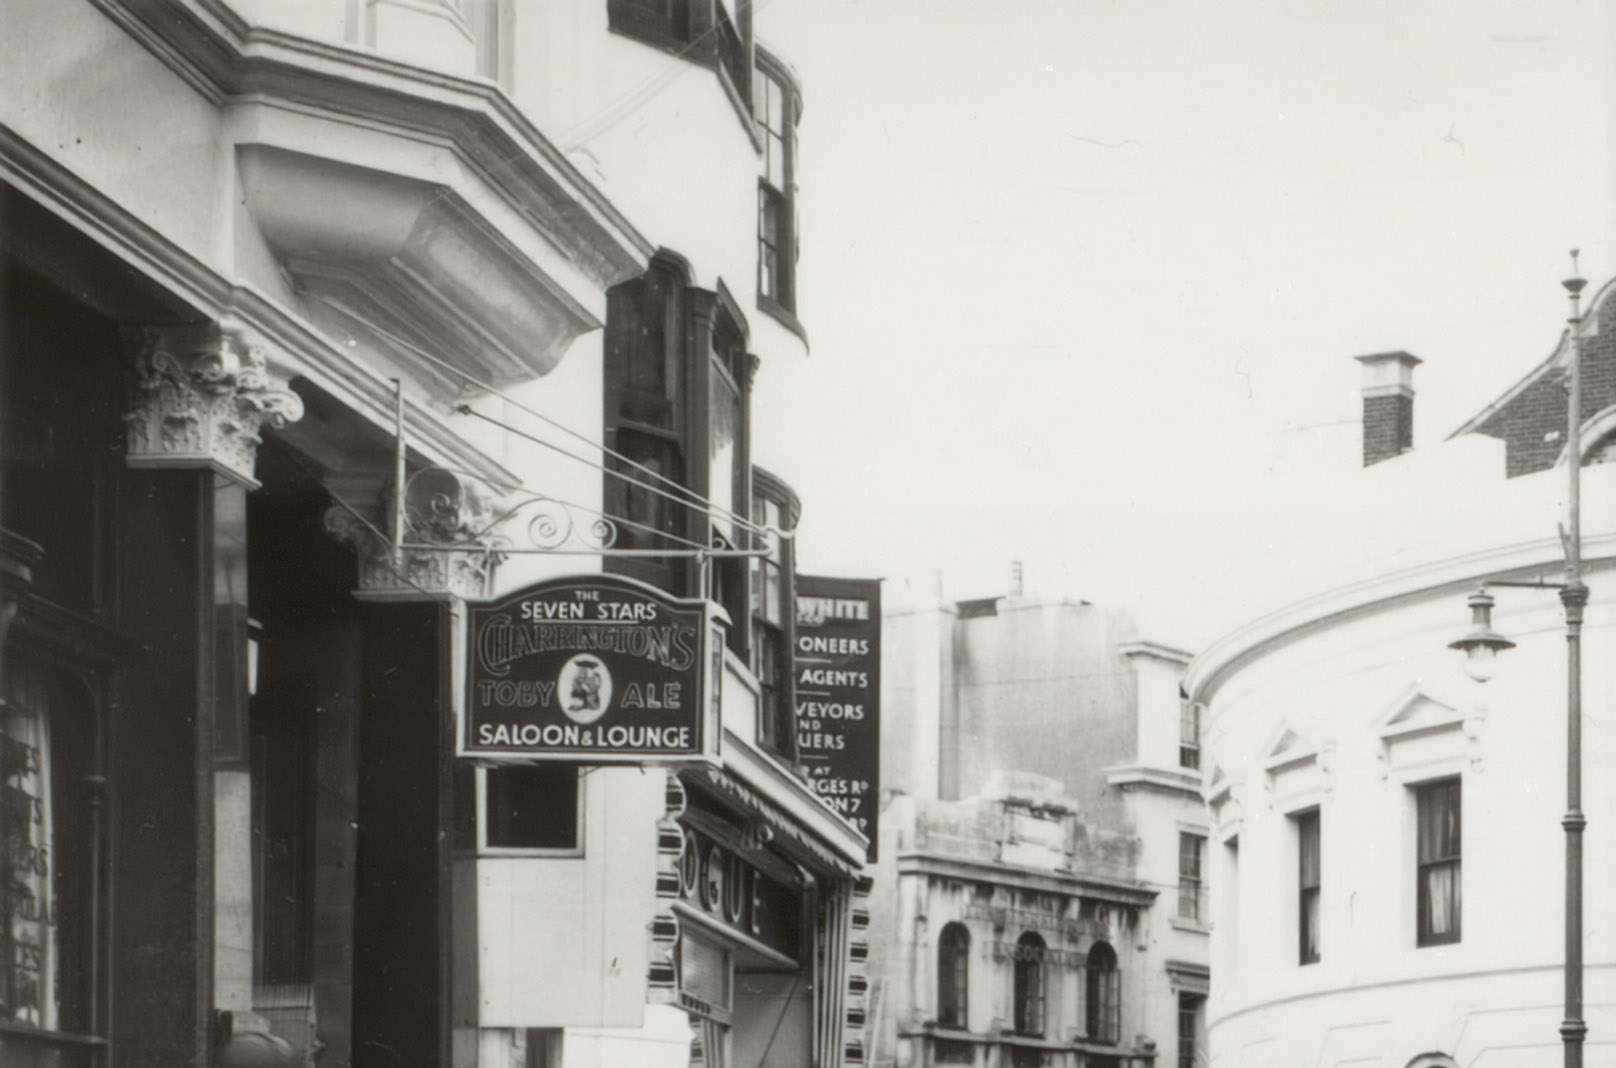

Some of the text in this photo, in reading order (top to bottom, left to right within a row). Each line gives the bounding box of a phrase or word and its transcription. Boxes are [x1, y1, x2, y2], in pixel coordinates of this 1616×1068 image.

[575, 590, 601, 601] THE
[521, 601, 657, 620] SEVEN STARS
[796, 636, 869, 655] ONEERS
[800, 668, 868, 688] AGENTS
[478, 680, 681, 709] TOBY ALE
[796, 701, 864, 720] VEYORS
[479, 723, 690, 747] SALOON & LOUNGE
[799, 720, 822, 731] ND
[798, 733, 845, 750] UERS
[820, 796, 861, 813] ON 7
